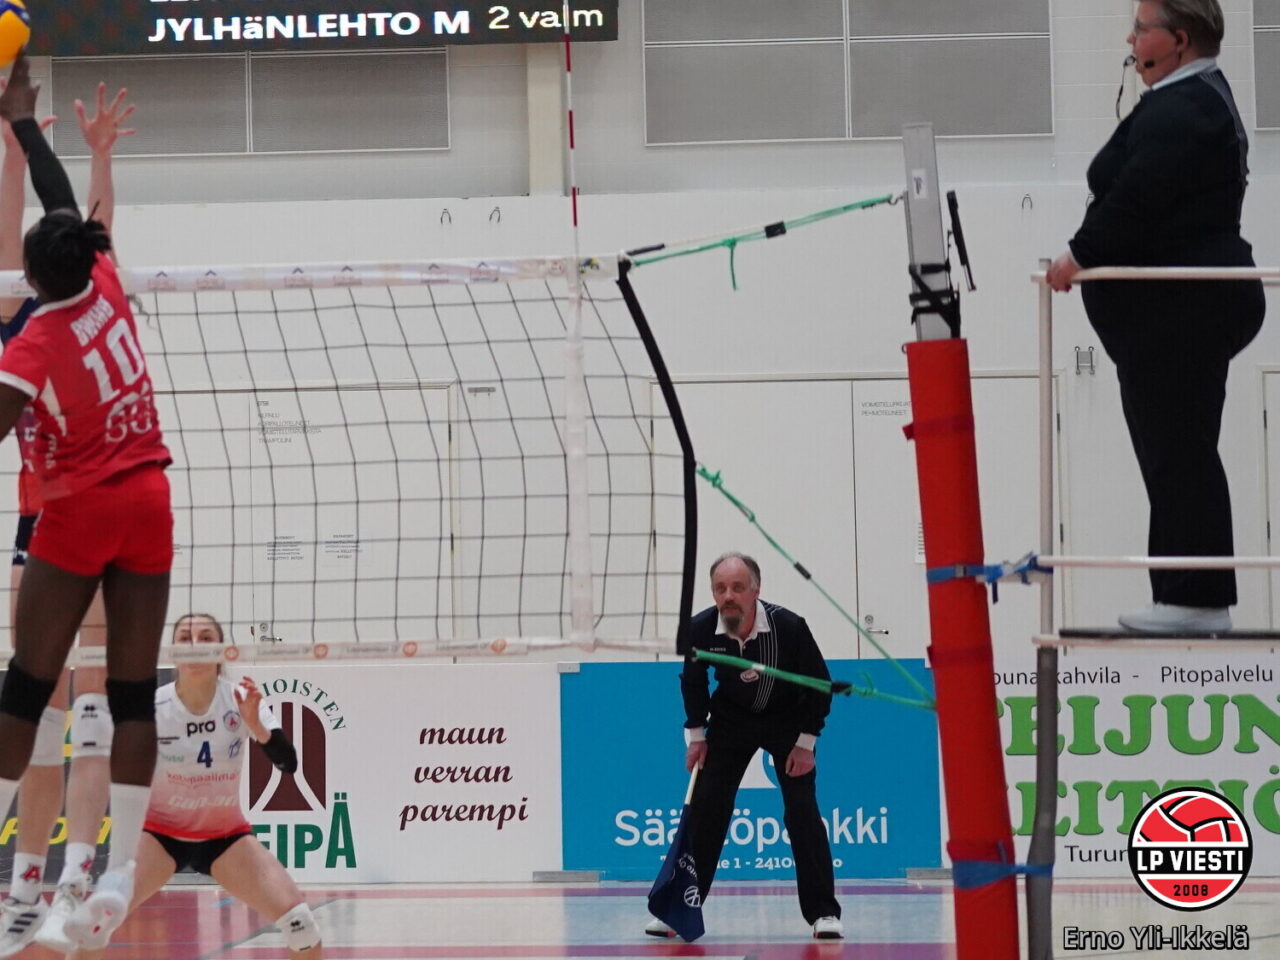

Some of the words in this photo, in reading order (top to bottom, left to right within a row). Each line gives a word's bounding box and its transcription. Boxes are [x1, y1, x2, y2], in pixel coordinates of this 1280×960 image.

[148, 12, 421, 41] JYLHäNLEHTO
[434, 11, 469, 34] M
[489, 6, 509, 29] 2
[82, 317, 145, 397] 10
[1161, 665, 1274, 687] Pitopalvelu
[419, 727, 507, 745] maun
[197, 741, 213, 768] 4
[414, 765, 514, 784] verran
[399, 796, 529, 831] parempi
[734, 857, 741, 868] 1
